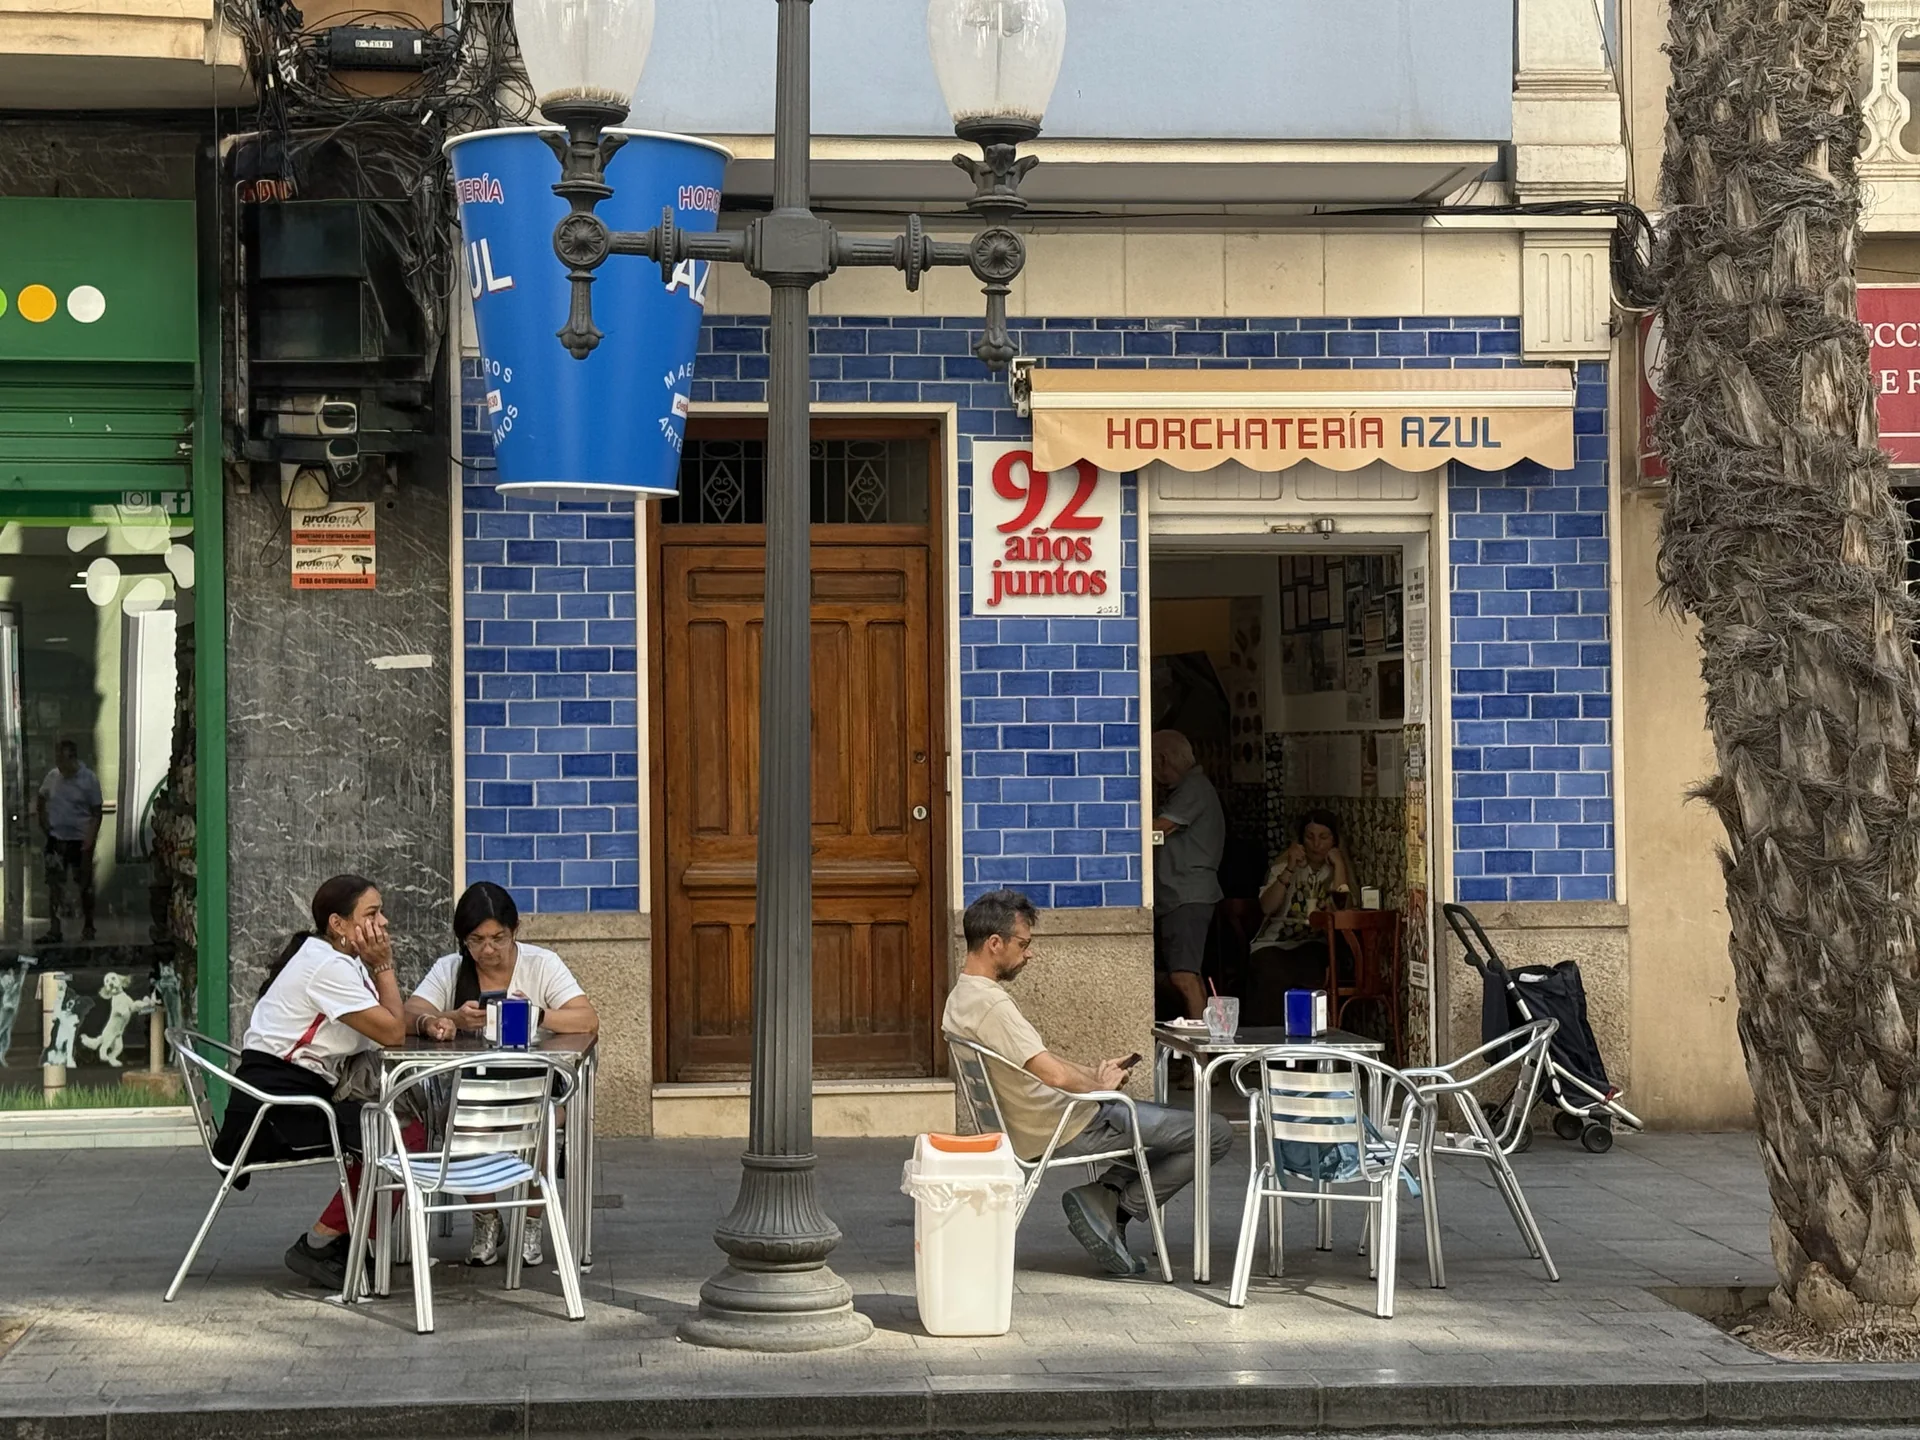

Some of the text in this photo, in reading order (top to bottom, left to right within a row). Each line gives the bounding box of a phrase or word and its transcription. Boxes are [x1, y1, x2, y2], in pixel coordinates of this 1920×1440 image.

[1106, 411, 1501, 450] HORCHATERÍA AZUL
[992, 450, 1104, 533] 92
[1004, 527, 1093, 562] años
[986, 560, 1108, 606] juntos
